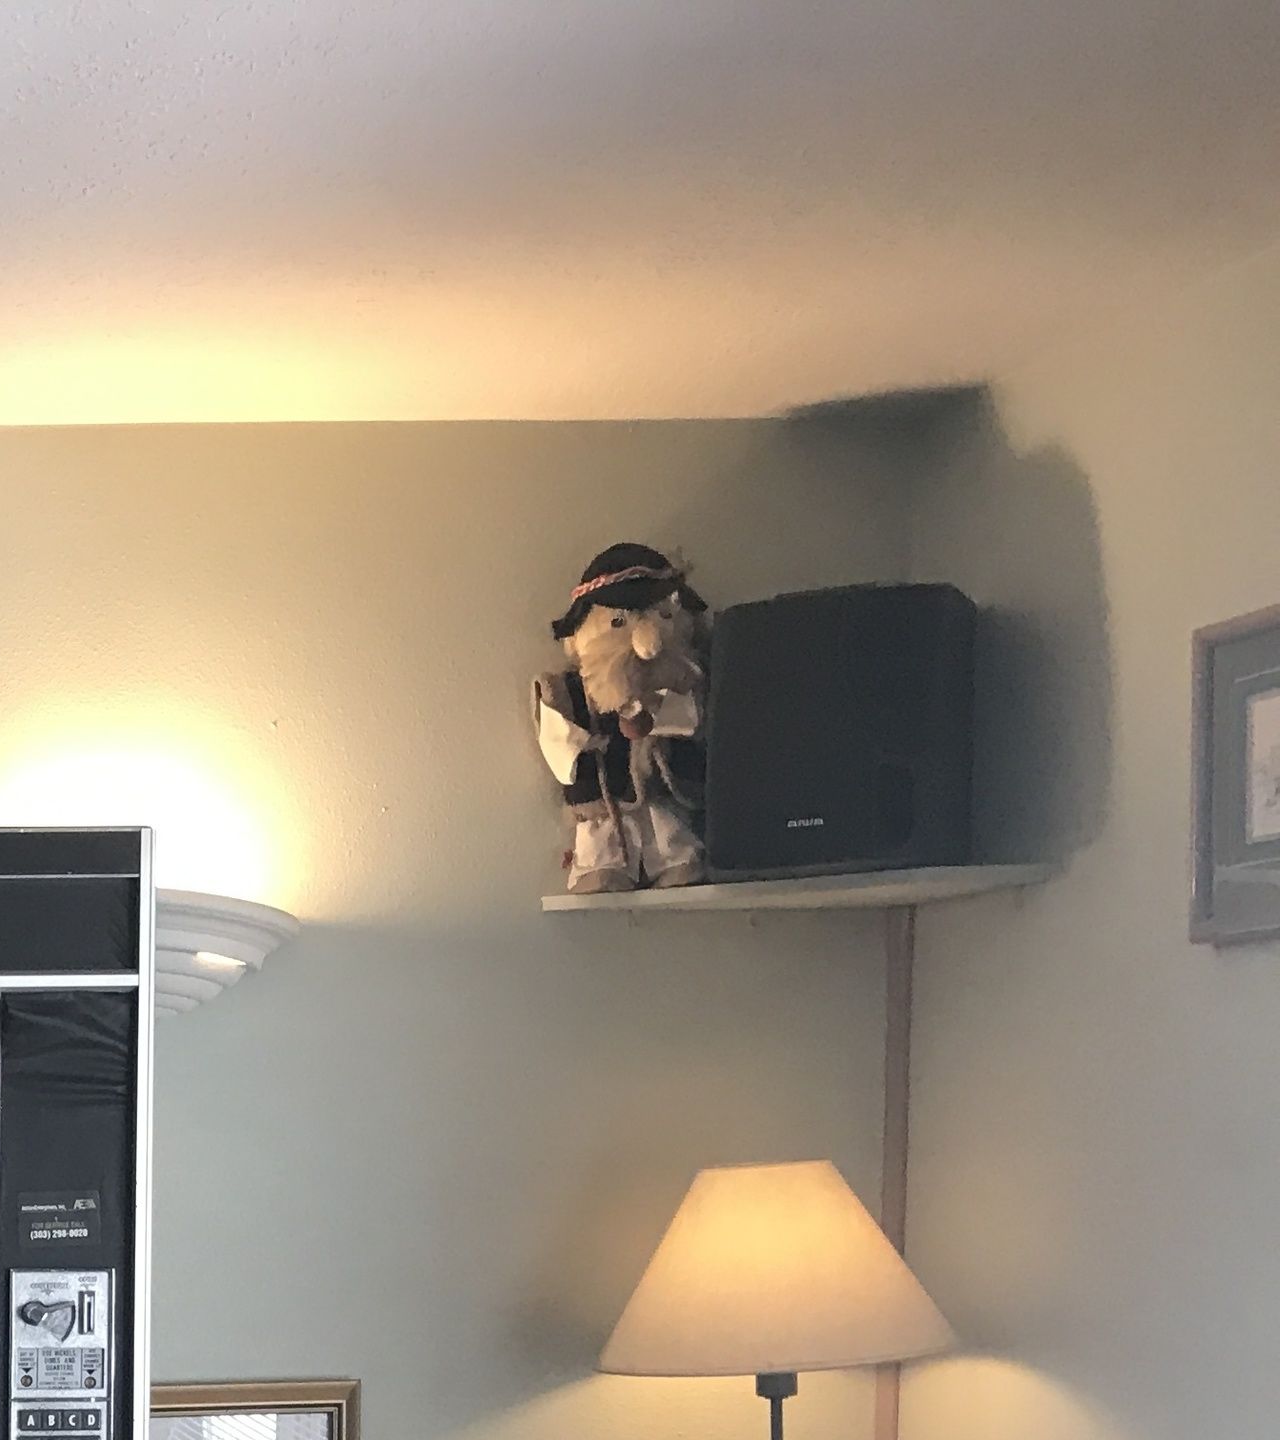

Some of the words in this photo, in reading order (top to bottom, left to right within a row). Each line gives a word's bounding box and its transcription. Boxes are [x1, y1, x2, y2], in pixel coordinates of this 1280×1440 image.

[27, 1415, 35, 1426] A
[48, 1415, 55, 1426] B
[69, 1415, 76, 1426] C
[88, 1414, 95, 1425] D
